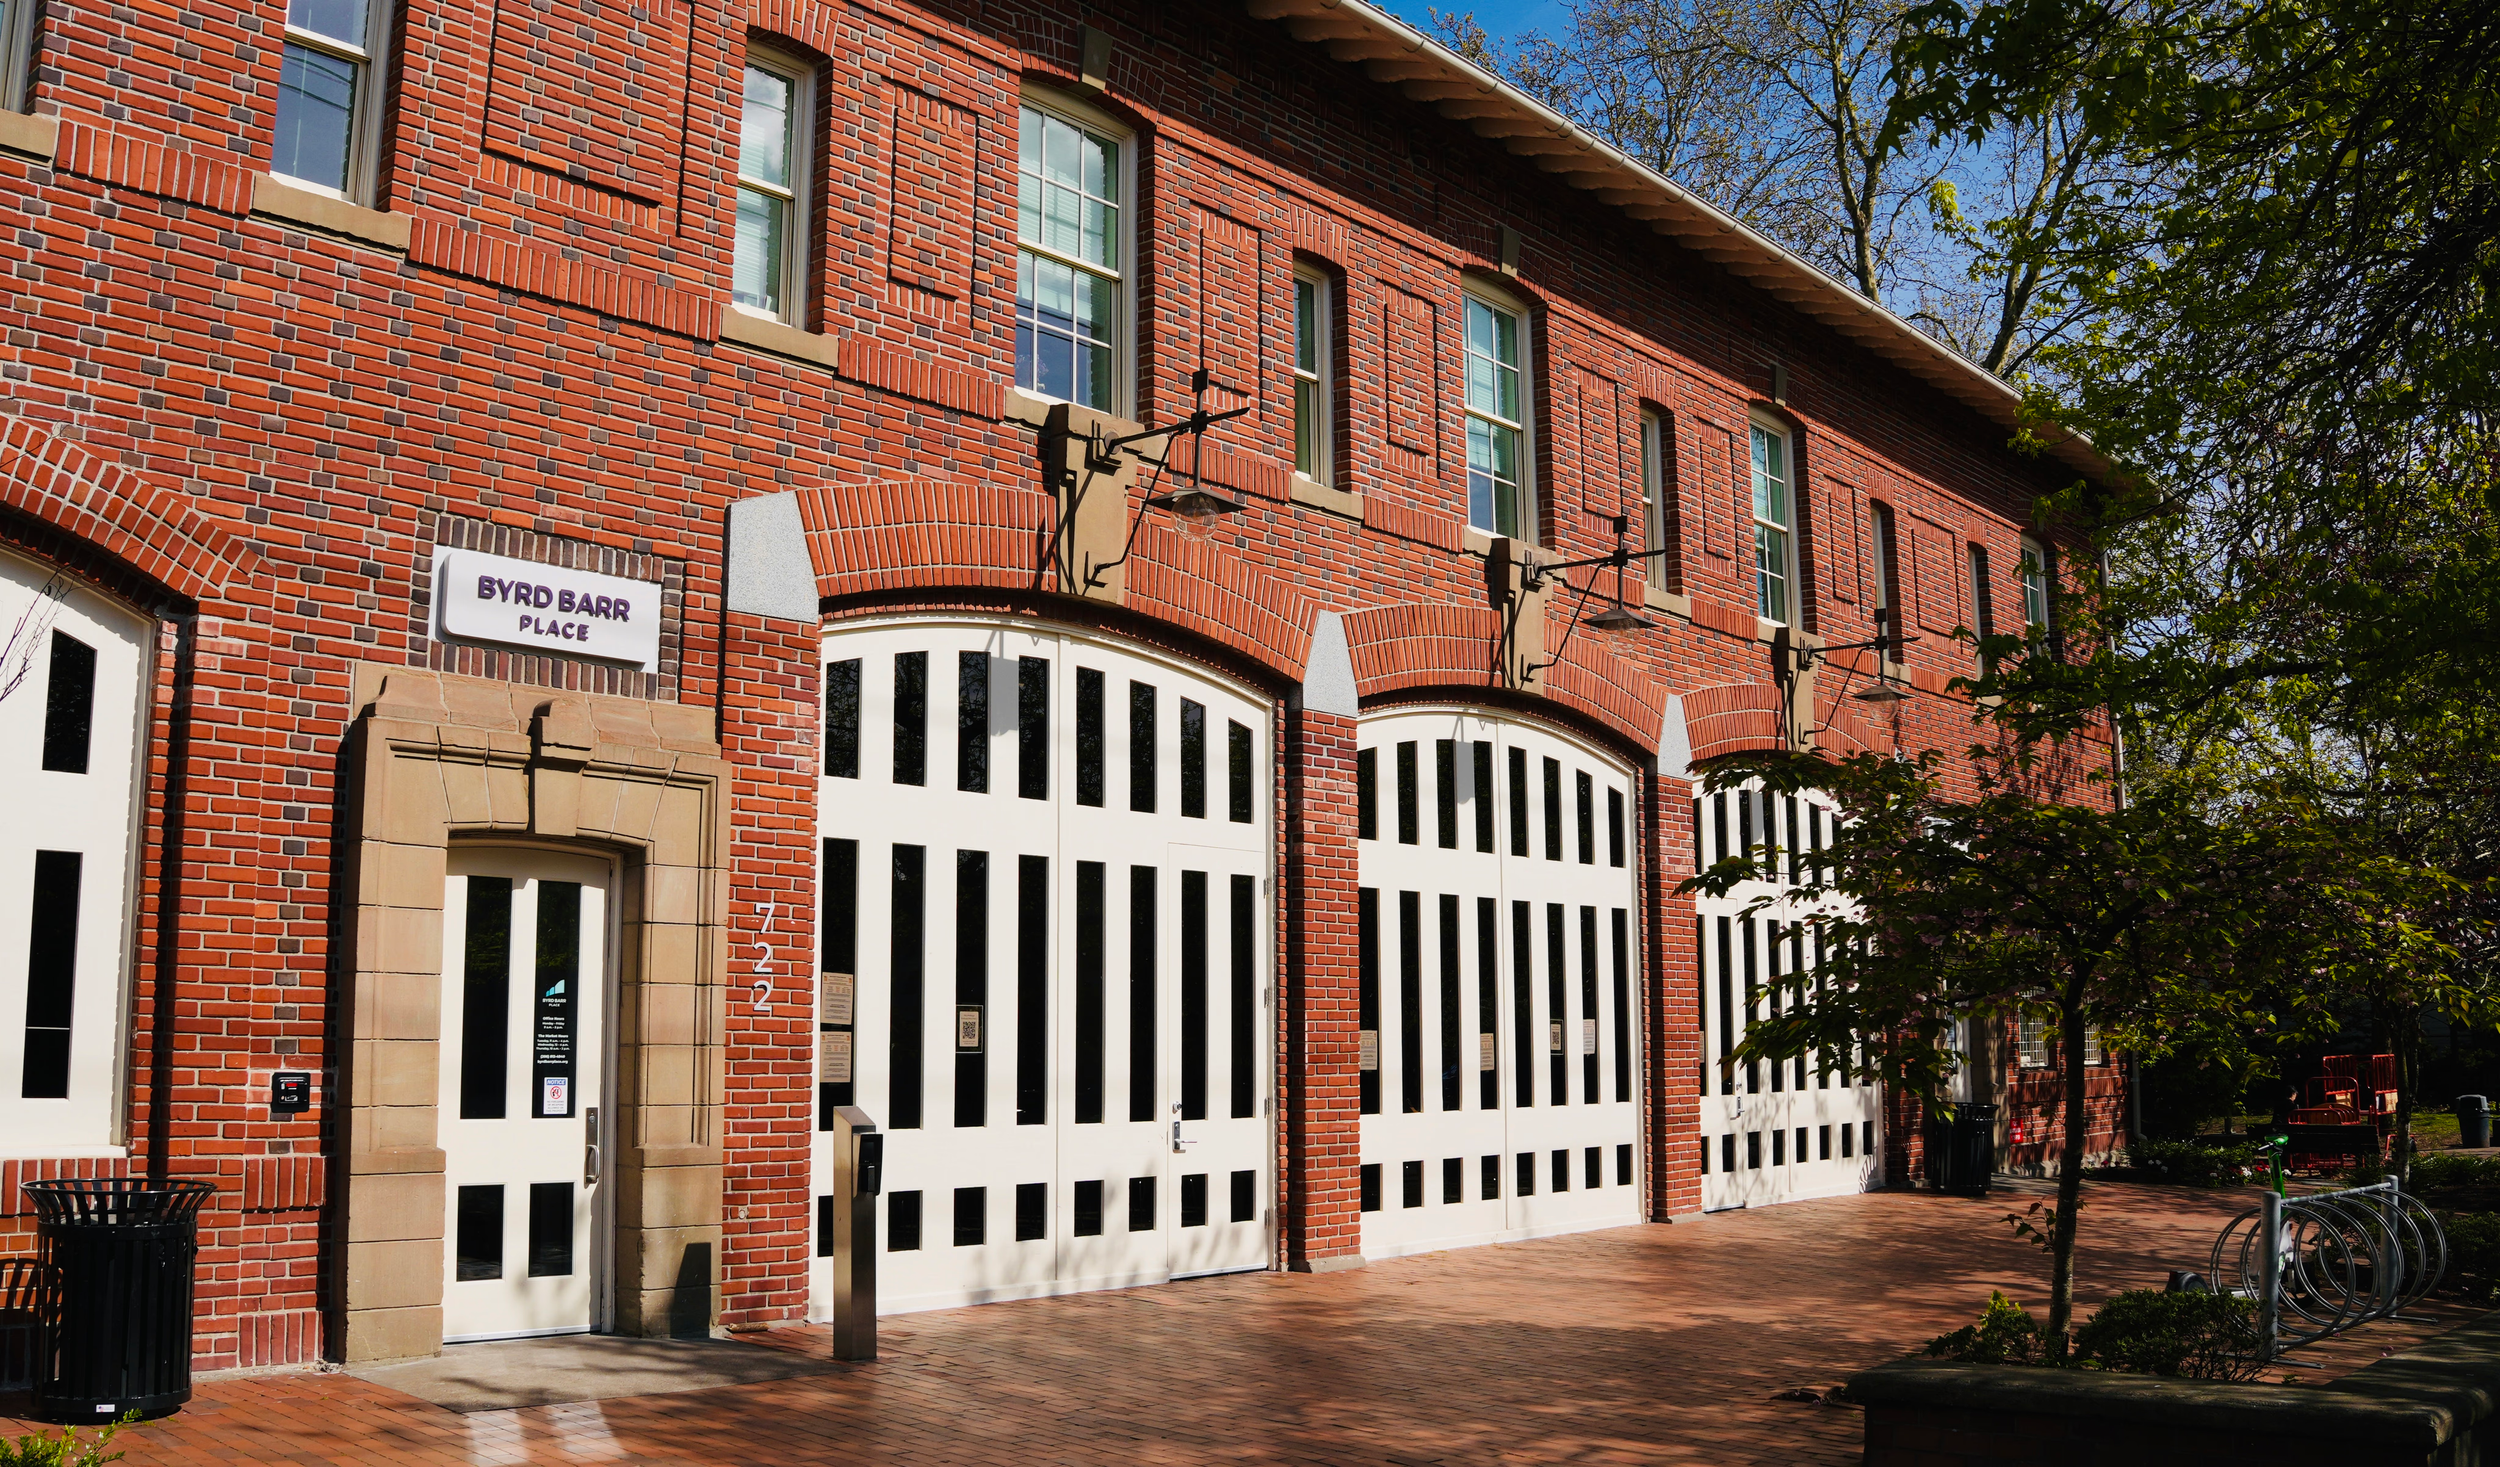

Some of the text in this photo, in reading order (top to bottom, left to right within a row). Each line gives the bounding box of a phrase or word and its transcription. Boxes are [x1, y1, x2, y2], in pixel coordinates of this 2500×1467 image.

[477, 575, 631, 621] BYRD BARR
[519, 614, 589, 641] PLACE
[753, 903, 775, 1012] 722
